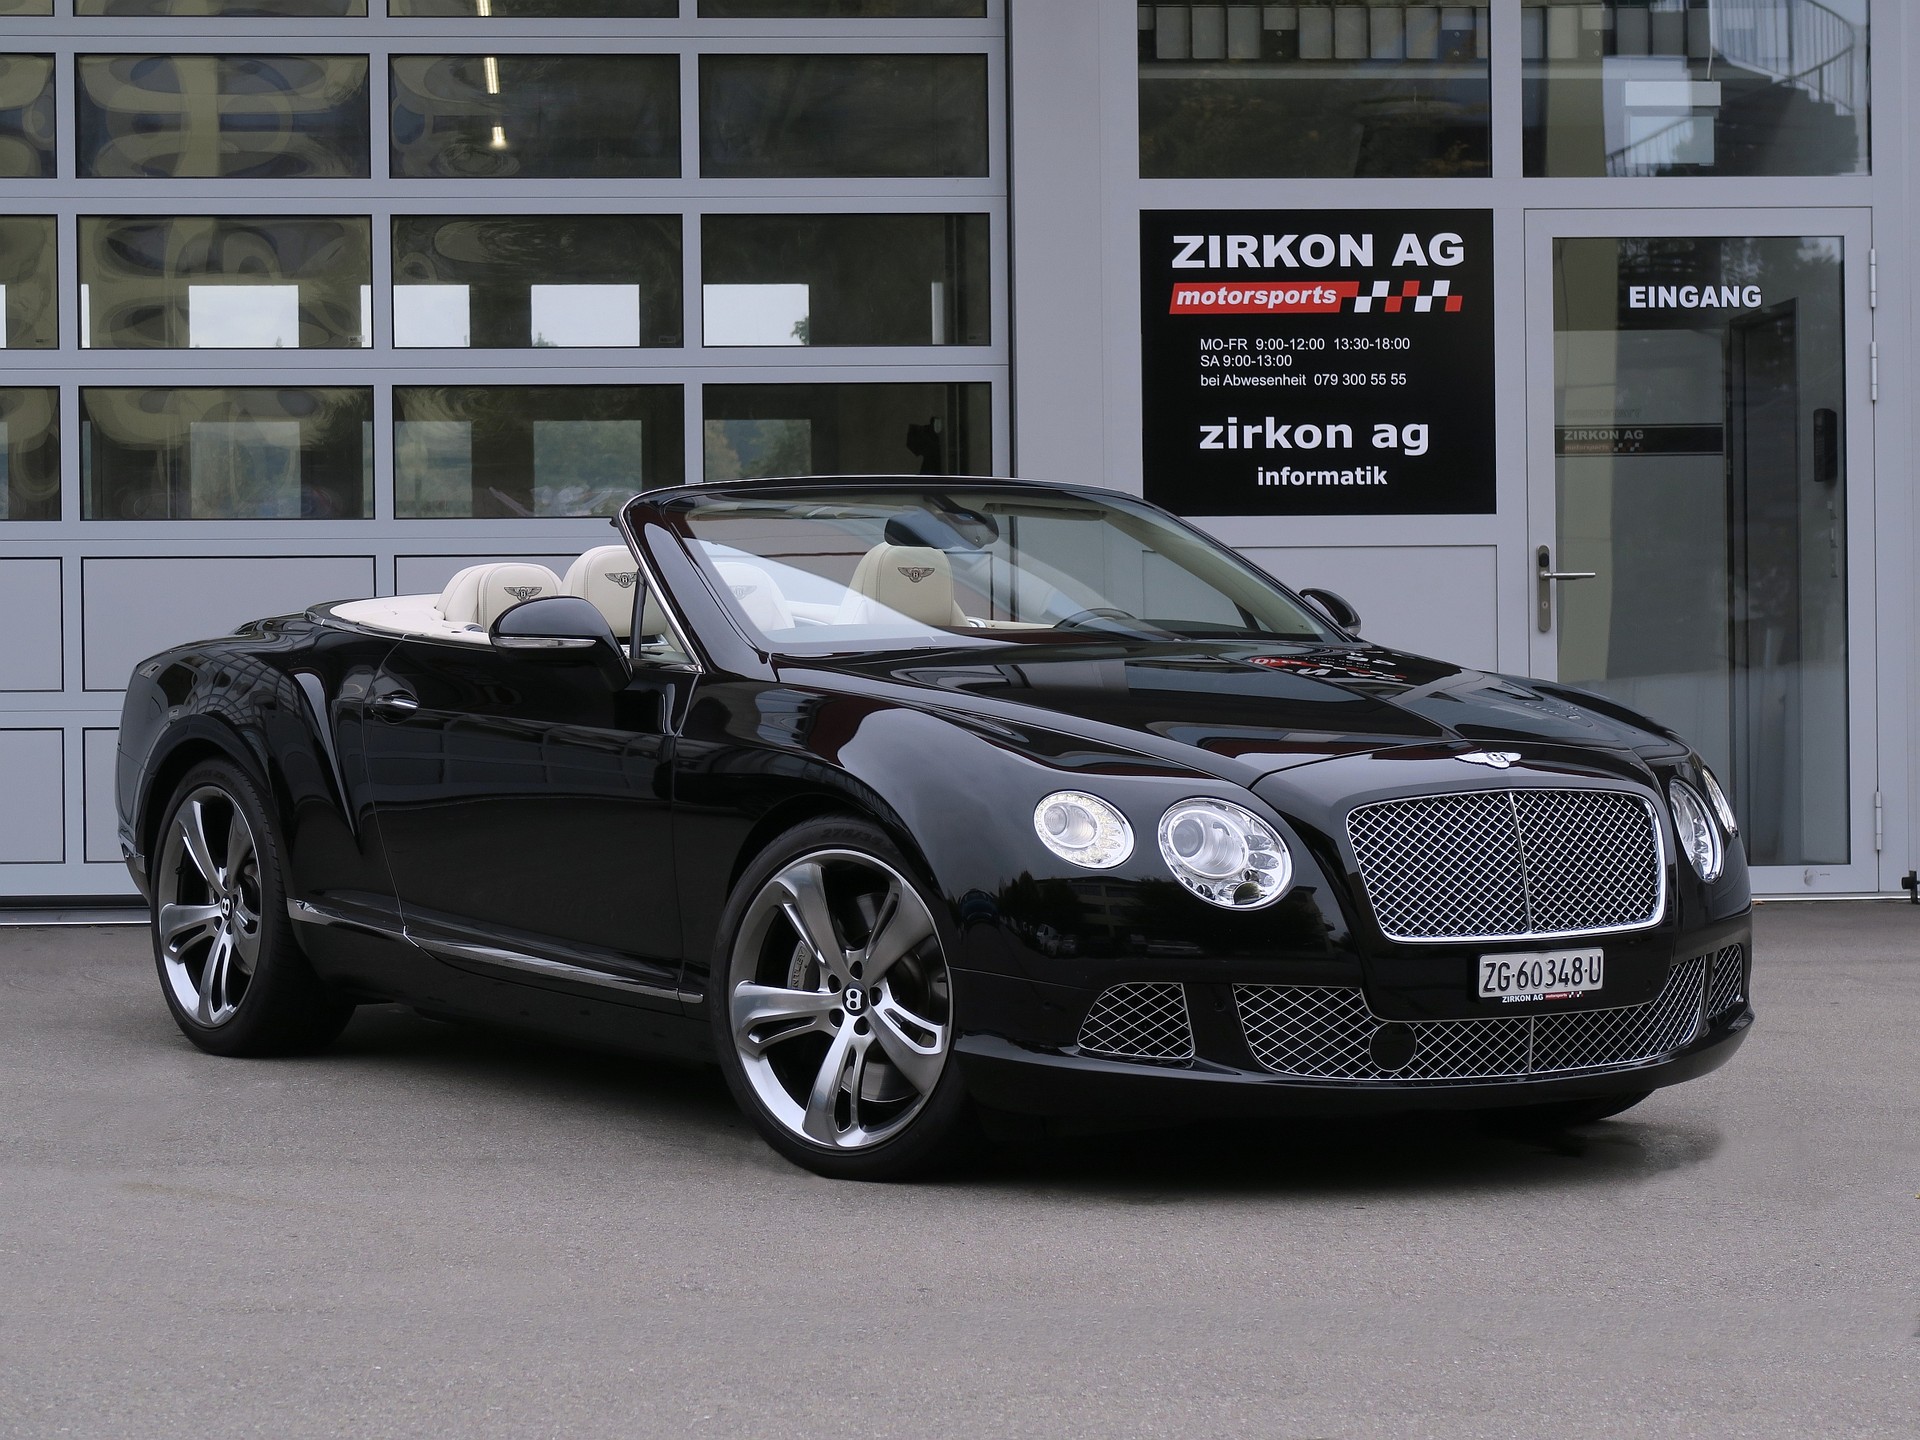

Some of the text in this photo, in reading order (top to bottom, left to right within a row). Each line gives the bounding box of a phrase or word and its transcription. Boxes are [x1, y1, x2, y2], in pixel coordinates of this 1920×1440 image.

[1171, 232, 1465, 269] ZIRKON AG
[1176, 285, 1337, 309] motorsports
[1629, 285, 1762, 308] EINGANG
[1200, 337, 1411, 351] MO-FR 9:00-12:00 13:30-18:00
[1200, 354, 1293, 367] SA 9:00-13:00
[1200, 373, 1407, 387] bei Abwesenheit 079 300 55 55
[1199, 416, 1429, 457] zirkon ag
[1563, 430, 1644, 441] ZIRKON AG
[1257, 465, 1388, 486] informatik
[1501, 993, 1532, 1004] ZIRKON
[1532, 992, 1544, 1002] AG
